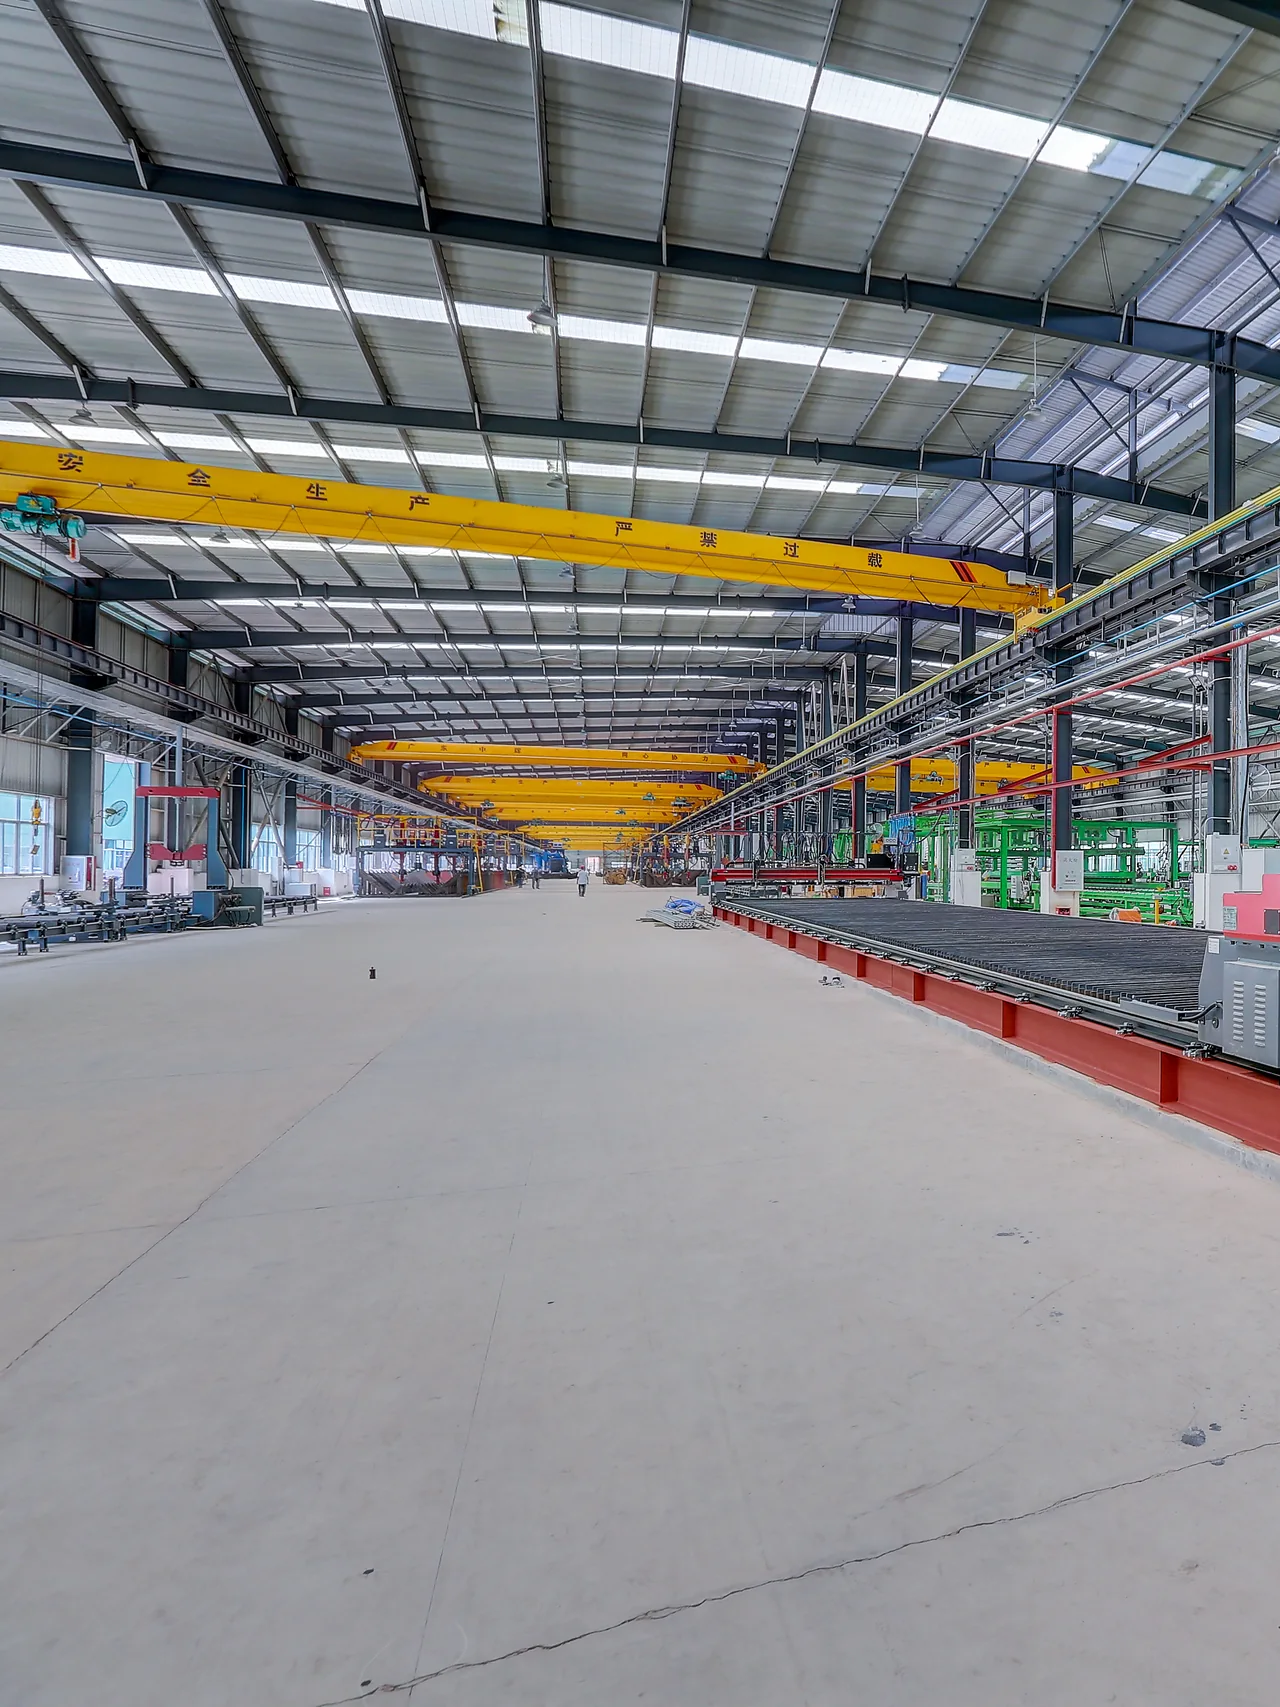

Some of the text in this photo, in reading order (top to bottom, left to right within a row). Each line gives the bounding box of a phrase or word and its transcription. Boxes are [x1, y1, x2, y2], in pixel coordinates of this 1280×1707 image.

[58, 453, 430, 511] 安全生产
[615, 521, 883, 568] 严禁过载
